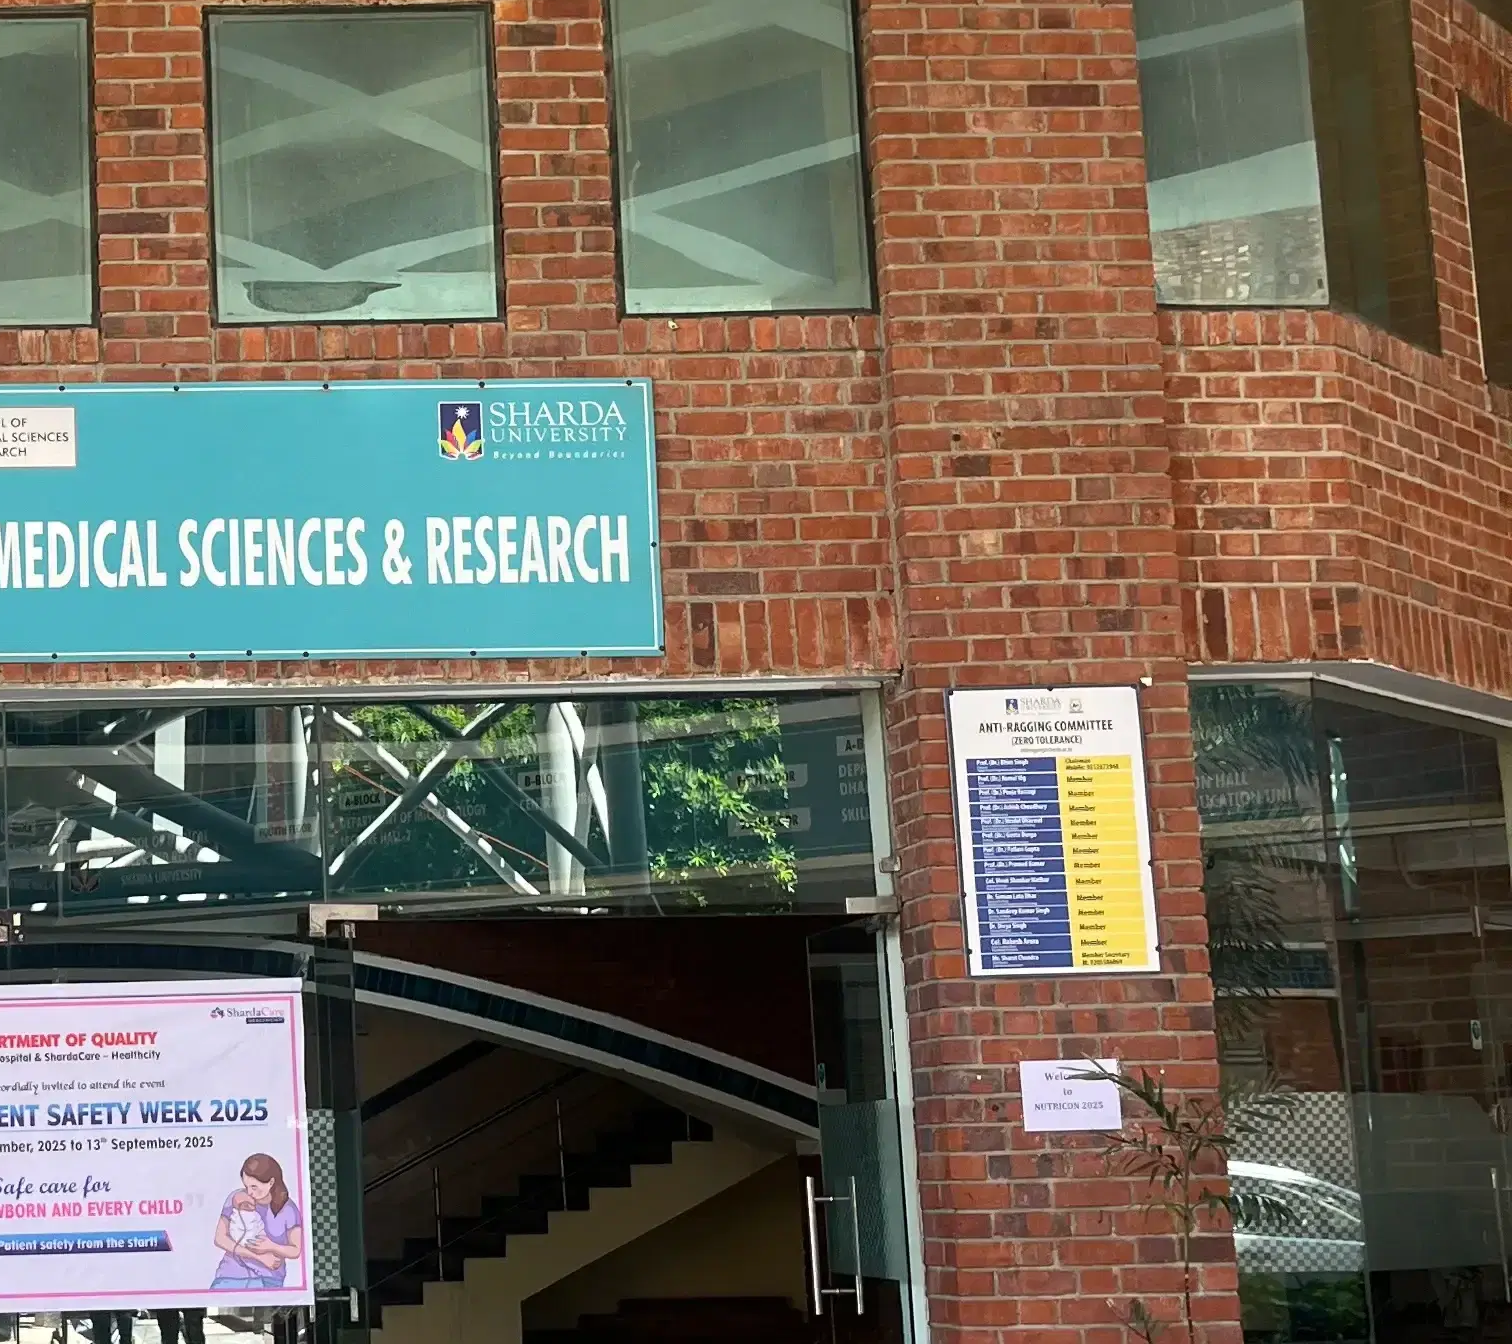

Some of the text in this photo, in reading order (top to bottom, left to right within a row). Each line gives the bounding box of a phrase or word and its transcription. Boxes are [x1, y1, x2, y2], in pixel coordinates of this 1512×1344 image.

[489, 400, 626, 427] SHARDA
[10, 417, 28, 428] OF
[17, 431, 70, 443] SCIENCES
[491, 427, 628, 443] UNIVERSITY
[493, 449, 540, 461] Beyond
[178, 516, 368, 587] SCIENCES
[381, 518, 413, 585] &
[426, 514, 630, 585] RESEARCH
[1054, 719, 1113, 732] COMMITTEE
[65, 1033, 86, 1047] OF
[91, 1031, 158, 1048] QUALITY
[34, 1053, 42, 1062] &
[44, 1052, 100, 1062] ShardaCare
[111, 1050, 161, 1062] Healthcity
[42, 1080, 75, 1091] invited
[77, 1081, 87, 1090] to
[89, 1079, 120, 1089] attend
[122, 1079, 137, 1089] the
[139, 1080, 166, 1088] event
[1063, 1087, 1073, 1096] to
[47, 1101, 131, 1127] SAFETY
[138, 1099, 203, 1124] WEEK
[209, 1098, 269, 1122] 2025
[1034, 1102, 1080, 1111] NUTRICON
[38, 1140, 67, 1152] 2025
[70, 1139, 83, 1151] to
[111, 1137, 181, 1152] September,
[184, 1136, 214, 1148] 2025
[39, 1181, 77, 1193] care
[82, 1175, 112, 1198] for
[51, 1201, 83, 1217] AND
[87, 1199, 133, 1217] EVERY
[138, 1198, 184, 1215] CHILD
[39, 1238, 74, 1253] safety
[76, 1238, 104, 1249] from
[105, 1237, 125, 1248] the
[127, 1235, 158, 1247] start!
